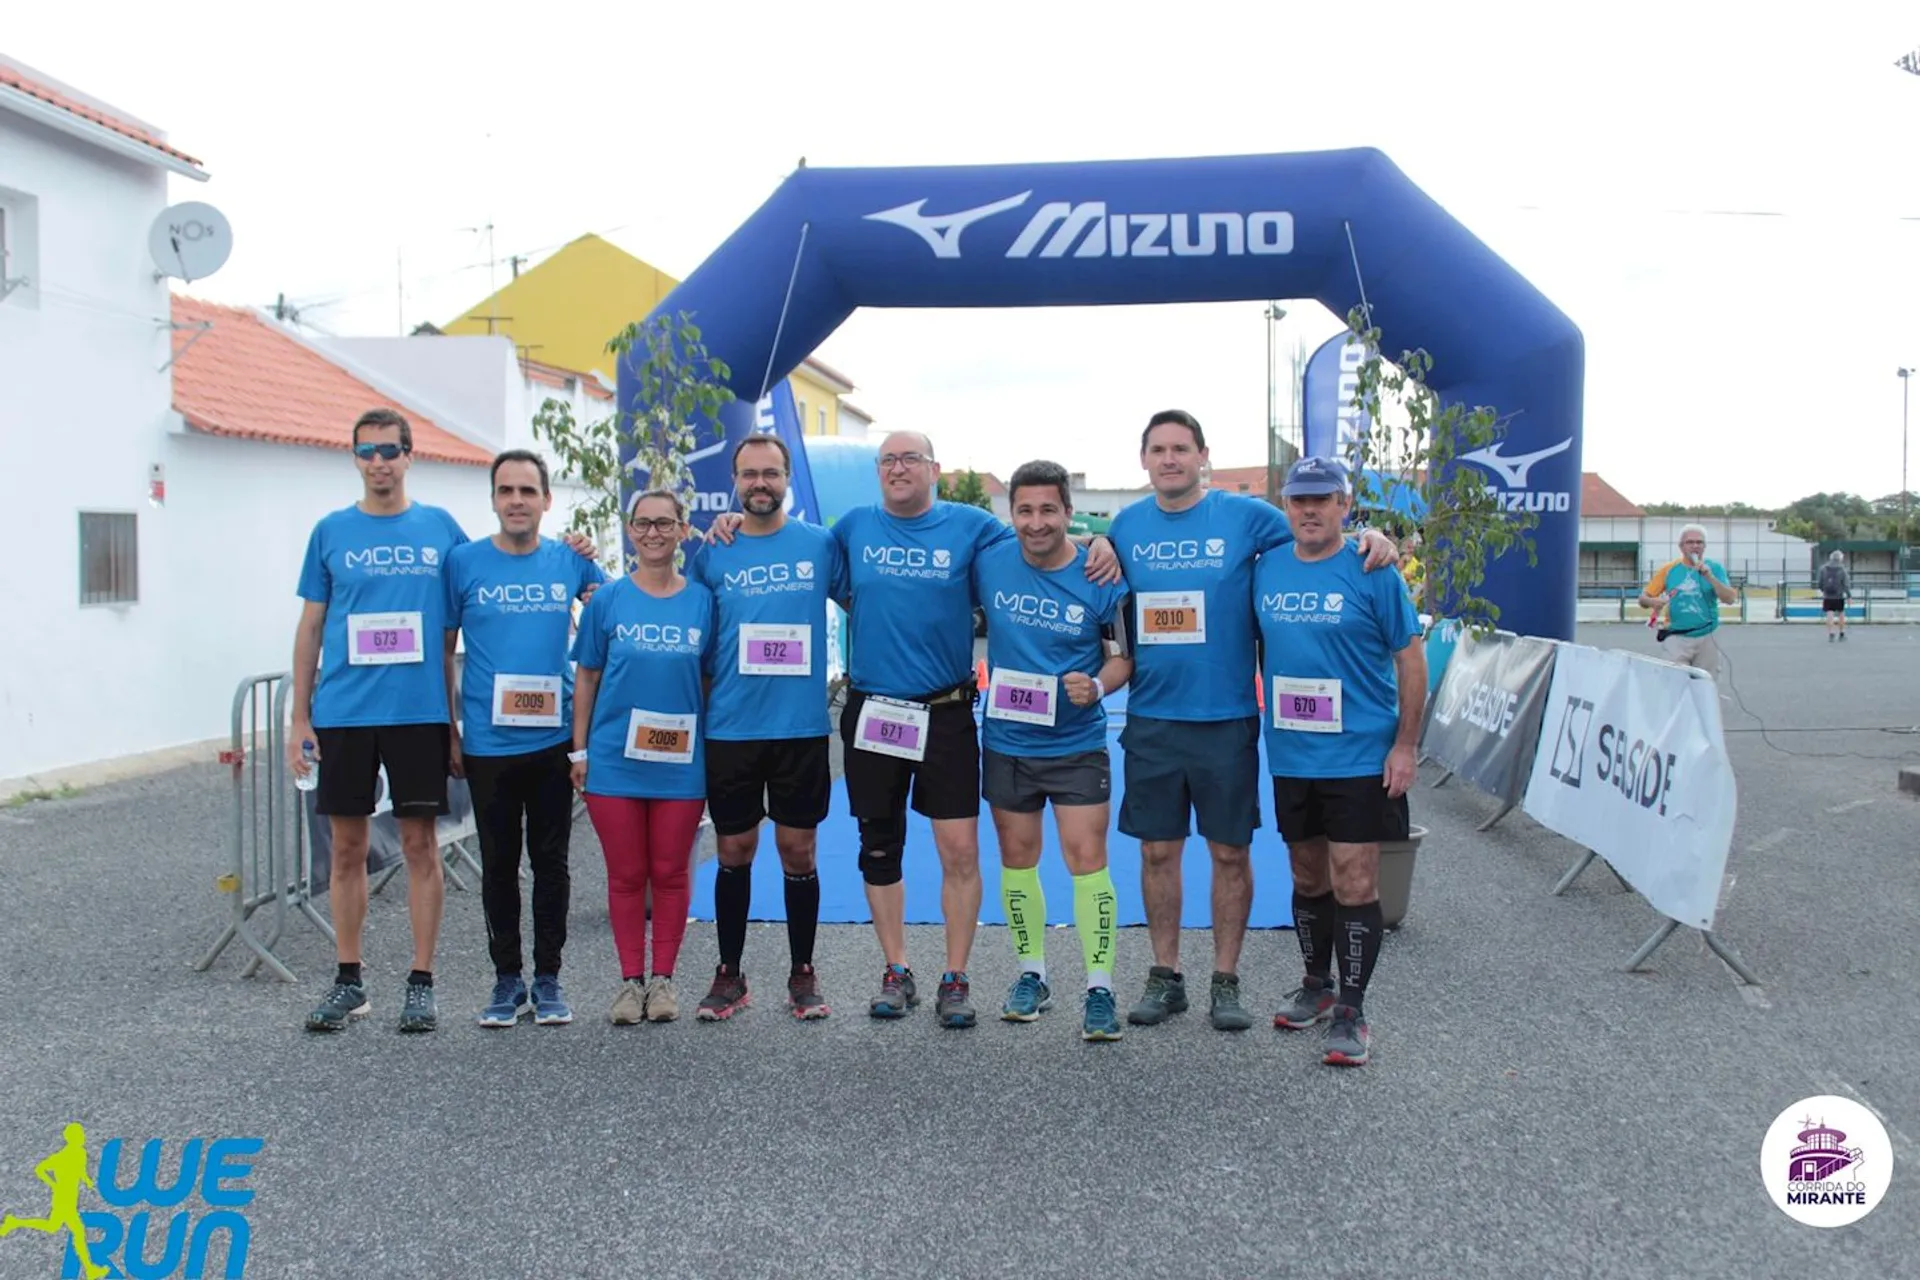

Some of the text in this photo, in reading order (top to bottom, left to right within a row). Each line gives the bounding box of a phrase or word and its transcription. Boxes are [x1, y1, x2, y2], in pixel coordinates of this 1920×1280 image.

[169, 219, 215, 241] NOS
[1004, 202, 1294, 257] MIZUNO
[345, 546, 415, 569] MCG
[863, 546, 926, 567] MCG
[1132, 540, 1198, 561] MCG
[374, 566, 438, 577] RUNNERS
[884, 566, 950, 579] RUNNERS
[1156, 559, 1223, 570] RUNNERS
[724, 563, 789, 591] MCG
[478, 584, 546, 604] MCG
[751, 582, 814, 596] RUNNERS
[505, 603, 568, 612] RUNNERS
[994, 590, 1059, 619] MCG
[1262, 592, 1319, 611] MCG
[1016, 614, 1082, 636] RUNNERS
[1154, 611, 1184, 626] 2010
[1277, 614, 1341, 624] RUNNERS
[373, 630, 398, 646] 673
[616, 624, 681, 643] MCG
[763, 642, 787, 657] 672
[514, 693, 545, 708] 2009
[1010, 689, 1034, 706] 674
[1294, 697, 1316, 713] 670
[648, 730, 679, 746] 2008
[880, 722, 904, 738] 671
